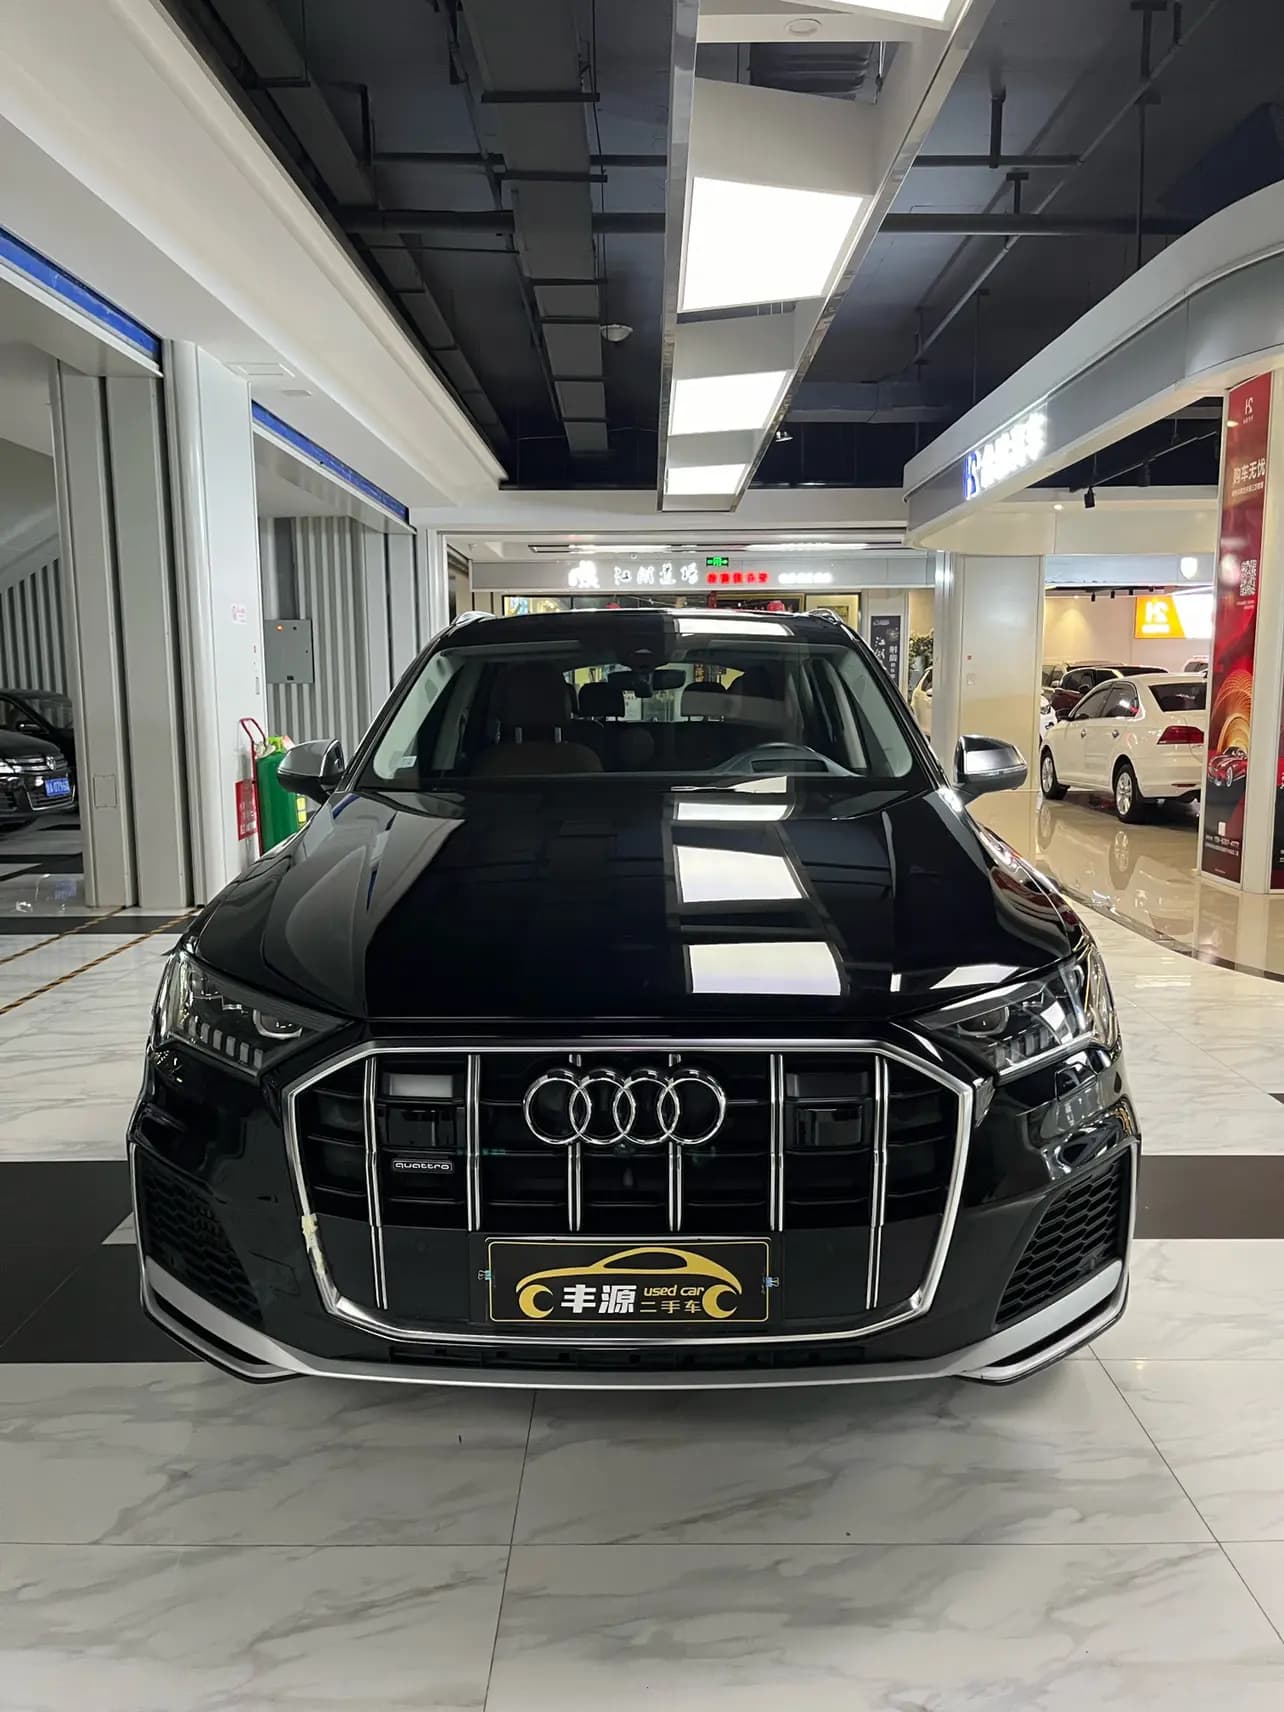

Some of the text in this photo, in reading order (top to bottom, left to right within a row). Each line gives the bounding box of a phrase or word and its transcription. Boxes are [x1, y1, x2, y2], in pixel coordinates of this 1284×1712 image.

[395, 1162, 450, 1170] quattro
[643, 1285, 704, 1297] used car
[561, 1284, 637, 1314] 丰源
[640, 1300, 702, 1314] 二手车
